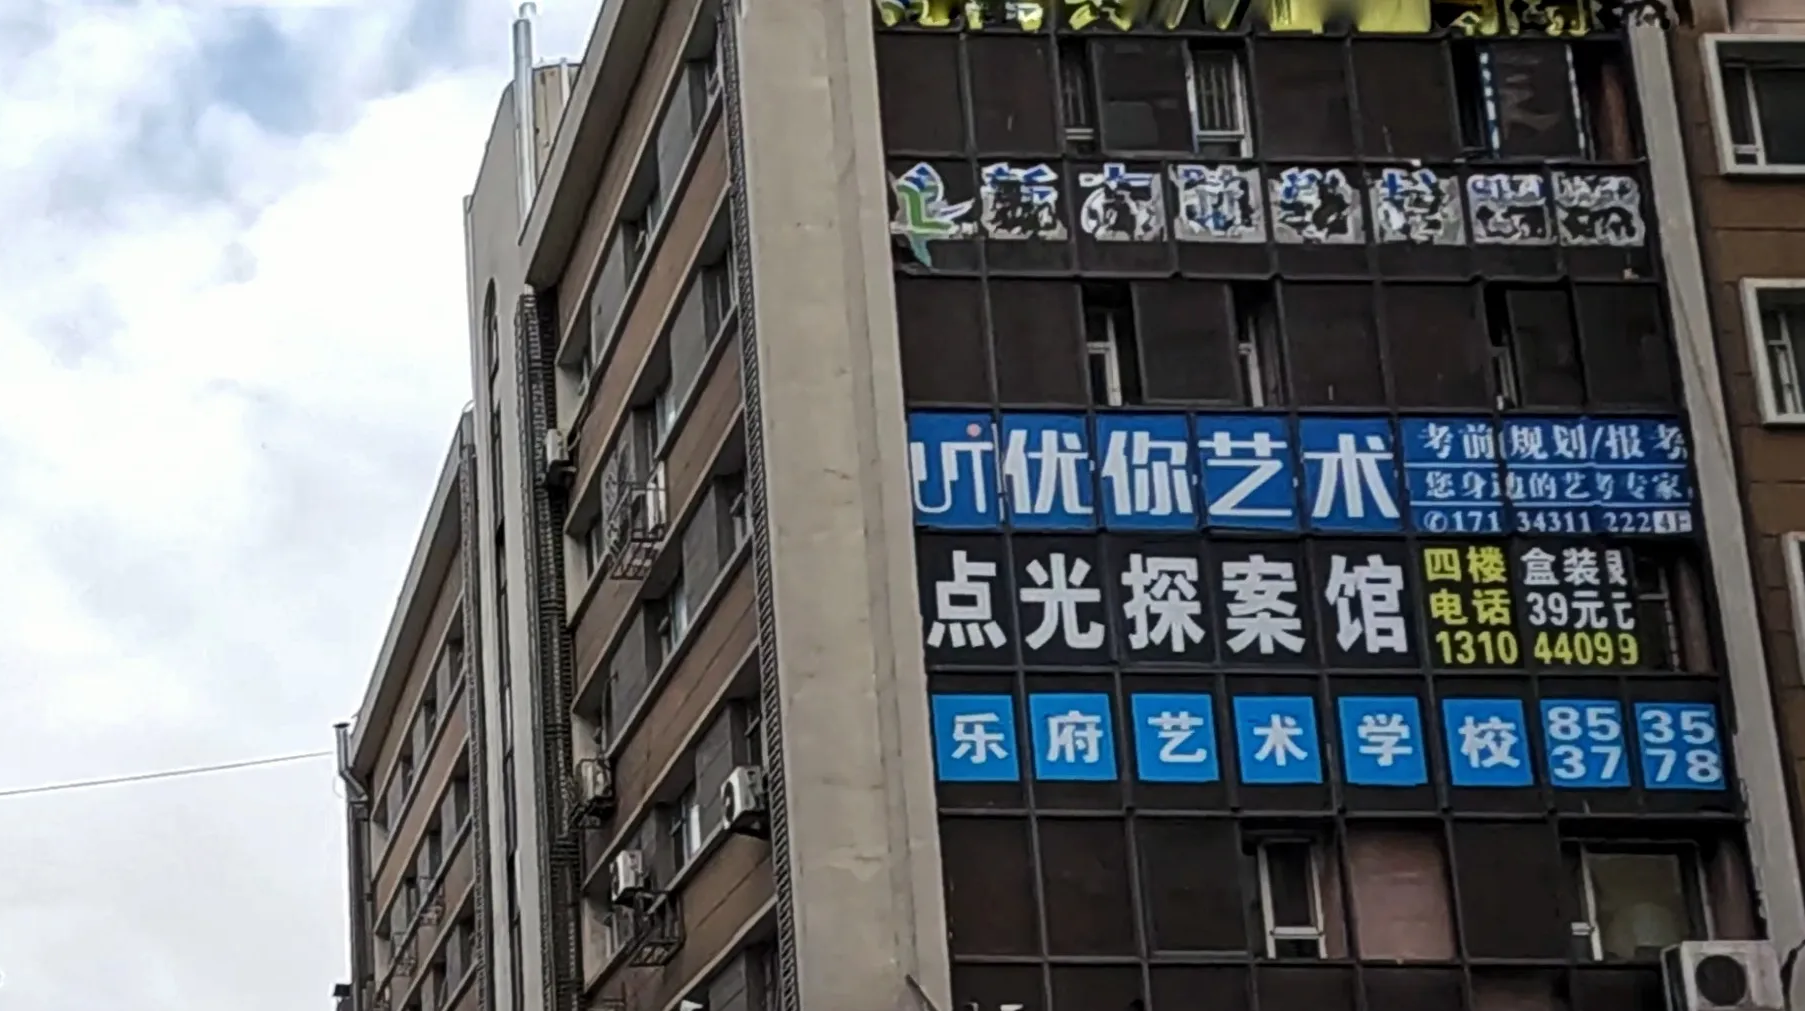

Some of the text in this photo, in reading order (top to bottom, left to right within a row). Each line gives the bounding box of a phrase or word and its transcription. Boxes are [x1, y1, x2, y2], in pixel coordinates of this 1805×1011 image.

[1002, 429, 1402, 518] 优你艺术
[1424, 547, 1507, 582] 四楼
[927, 551, 1407, 653] 点光探案馆
[1429, 588, 1512, 625] 电话
[952, 711, 1520, 768] 乐府艺术学校
